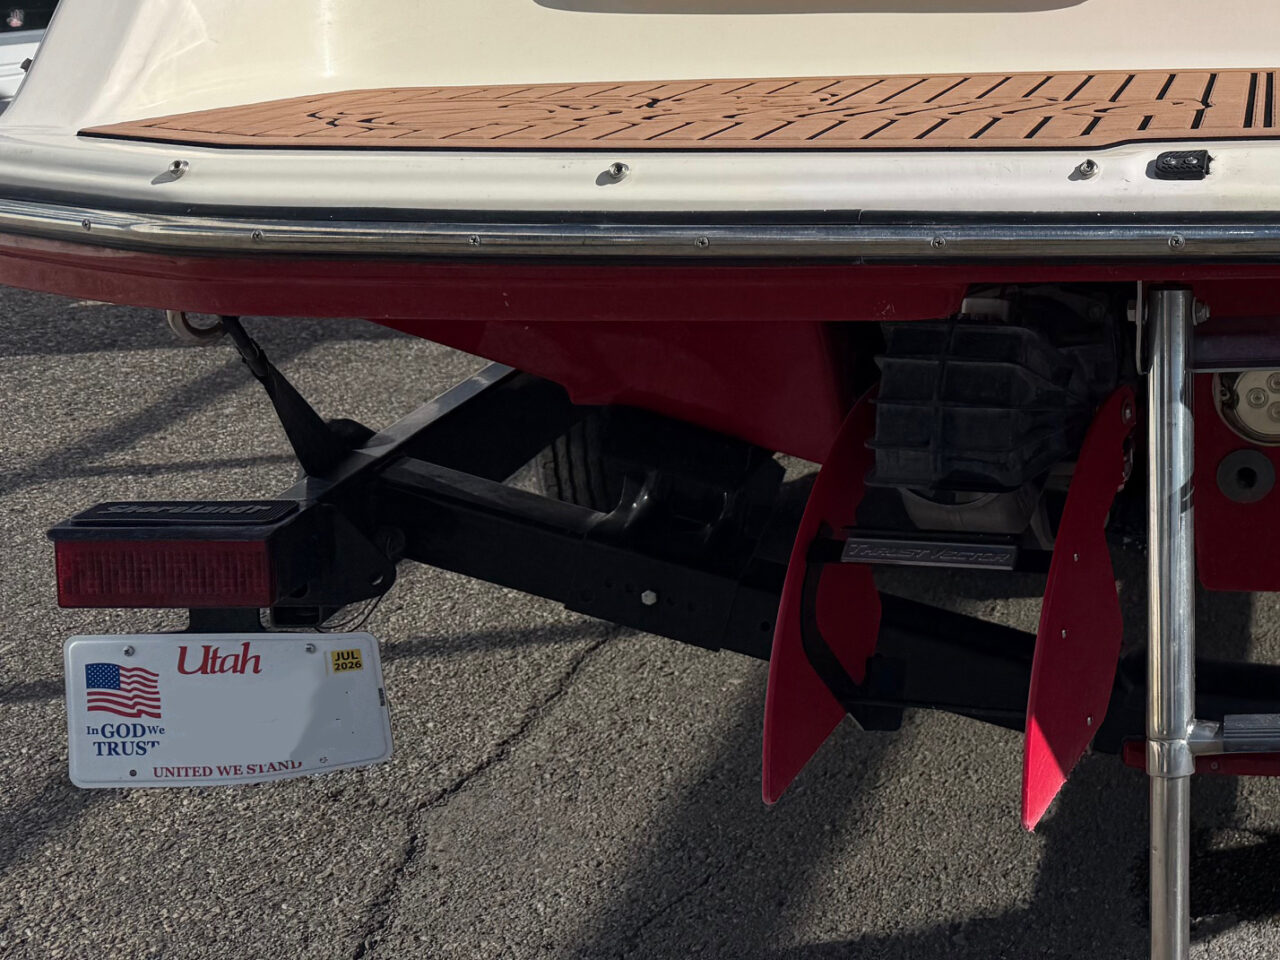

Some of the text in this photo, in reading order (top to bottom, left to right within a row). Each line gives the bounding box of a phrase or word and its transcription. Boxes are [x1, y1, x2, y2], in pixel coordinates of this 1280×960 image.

[178, 642, 262, 675] Utah
[334, 650, 359, 661] JUL
[334, 660, 362, 671] 2026
[86, 723, 165, 739] In GOD We
[153, 766, 213, 778] UNITED
[217, 765, 244, 776] WE
